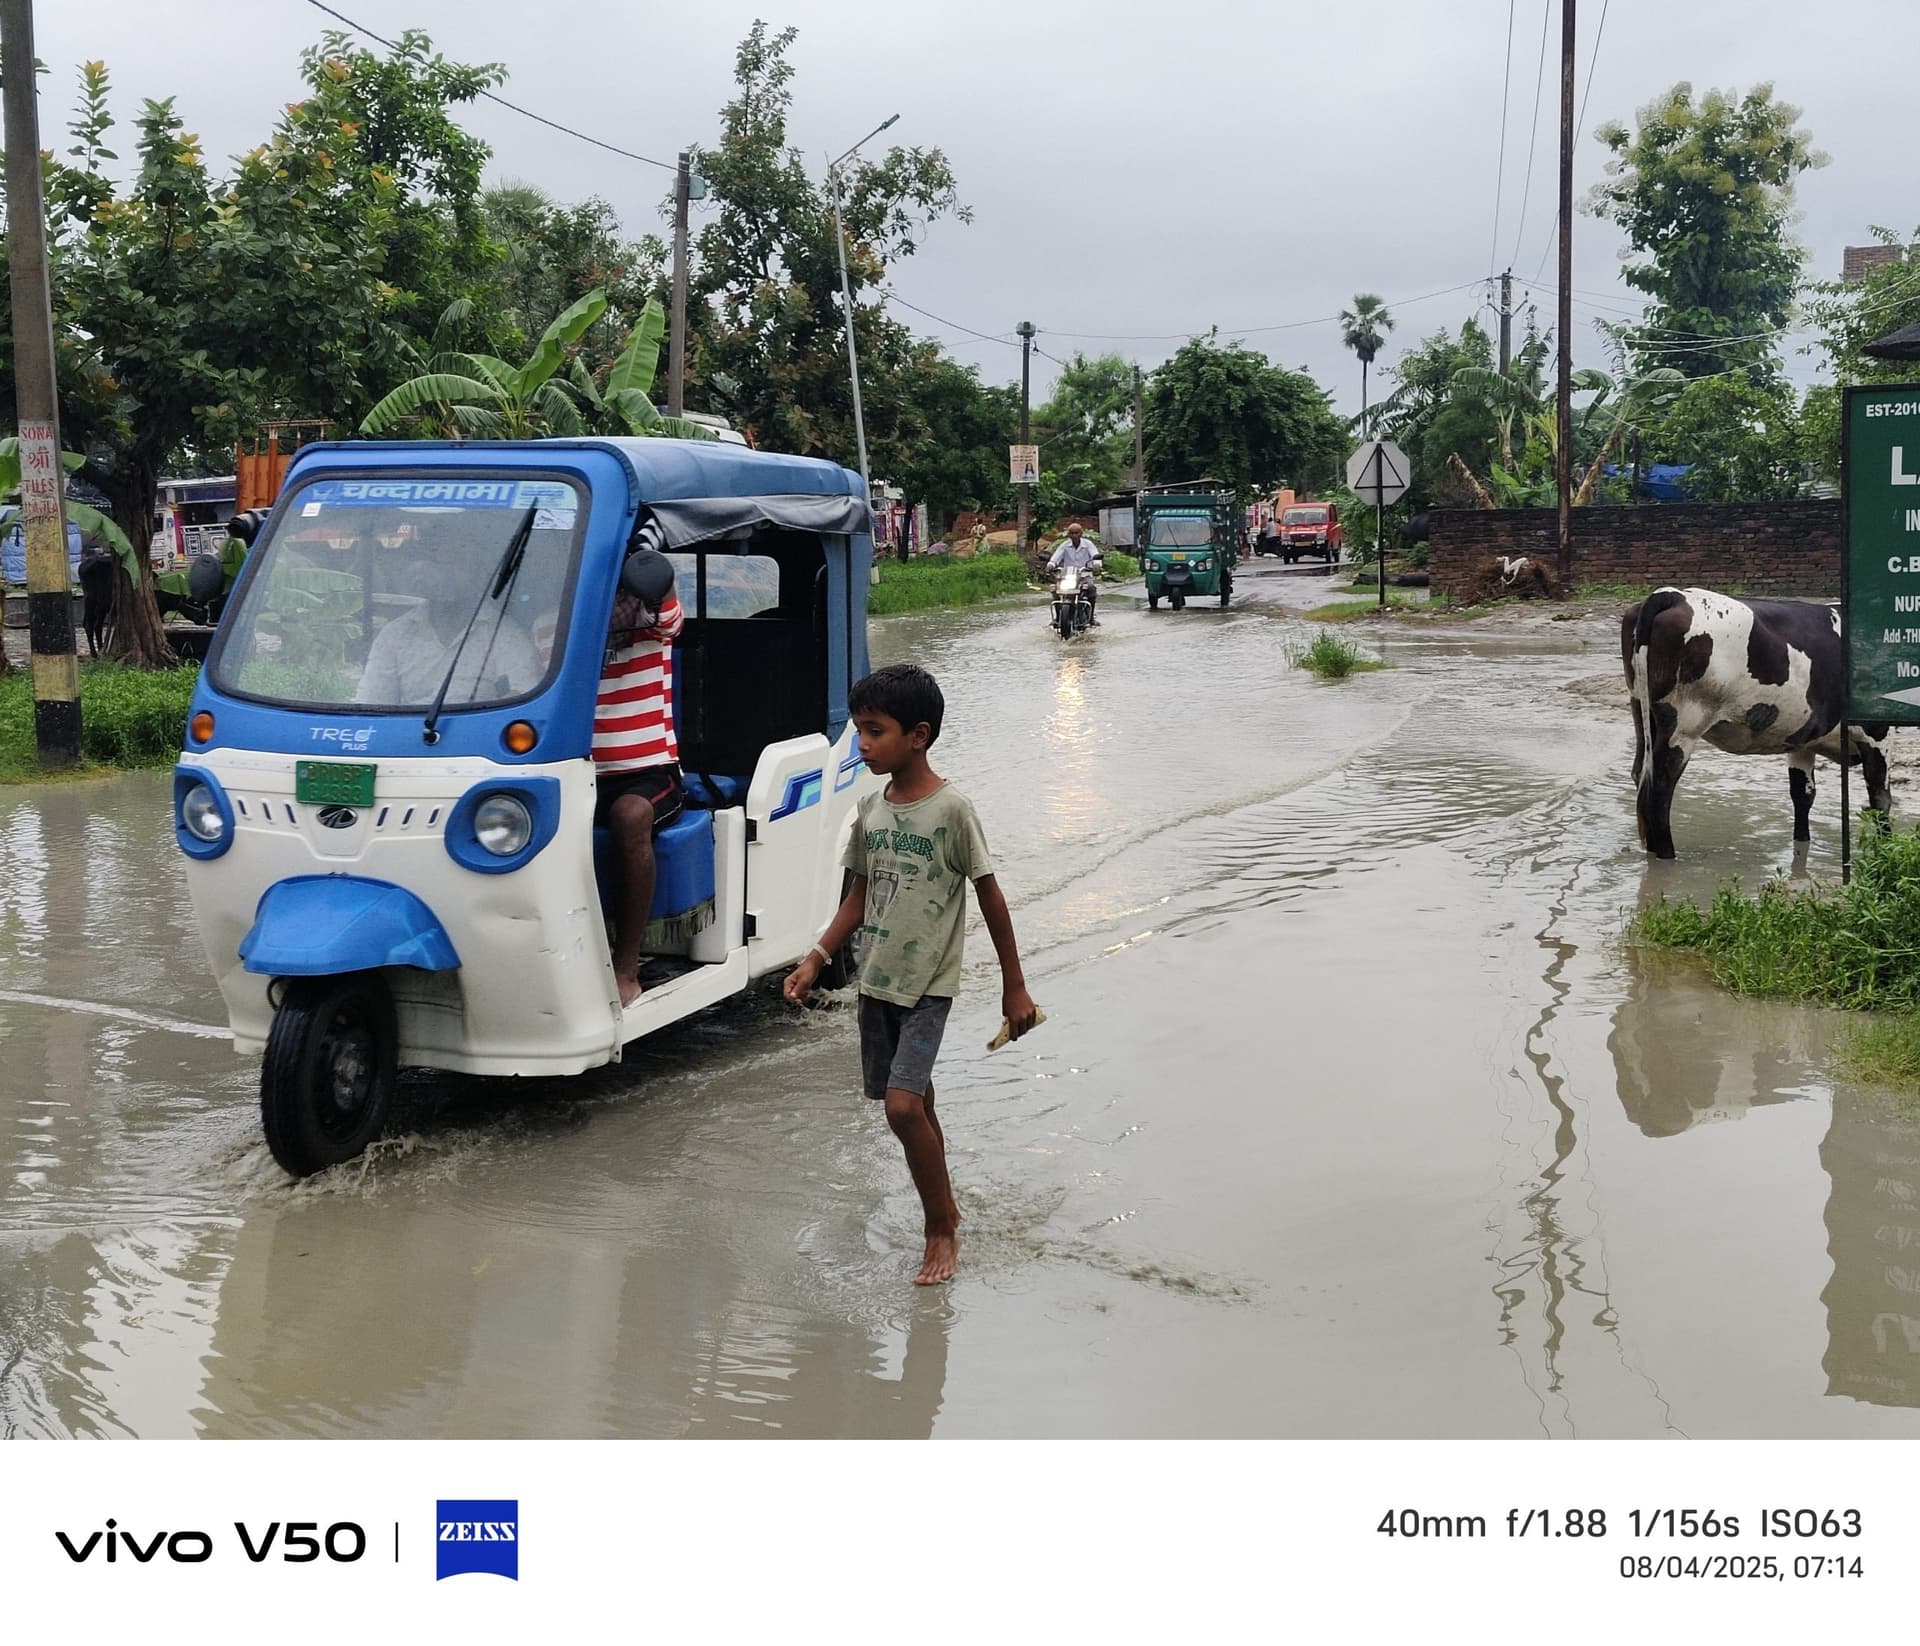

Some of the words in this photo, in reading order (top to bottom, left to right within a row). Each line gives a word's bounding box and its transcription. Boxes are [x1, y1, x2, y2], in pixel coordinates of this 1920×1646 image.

[1866, 402, 1920, 417] EST-201
[21, 426, 54, 441] SONA
[1891, 446, 1920, 485] L
[343, 483, 514, 500] चन्दामामा
[1883, 628, 1901, 643] Add
[341, 743, 368, 751] PLUS
